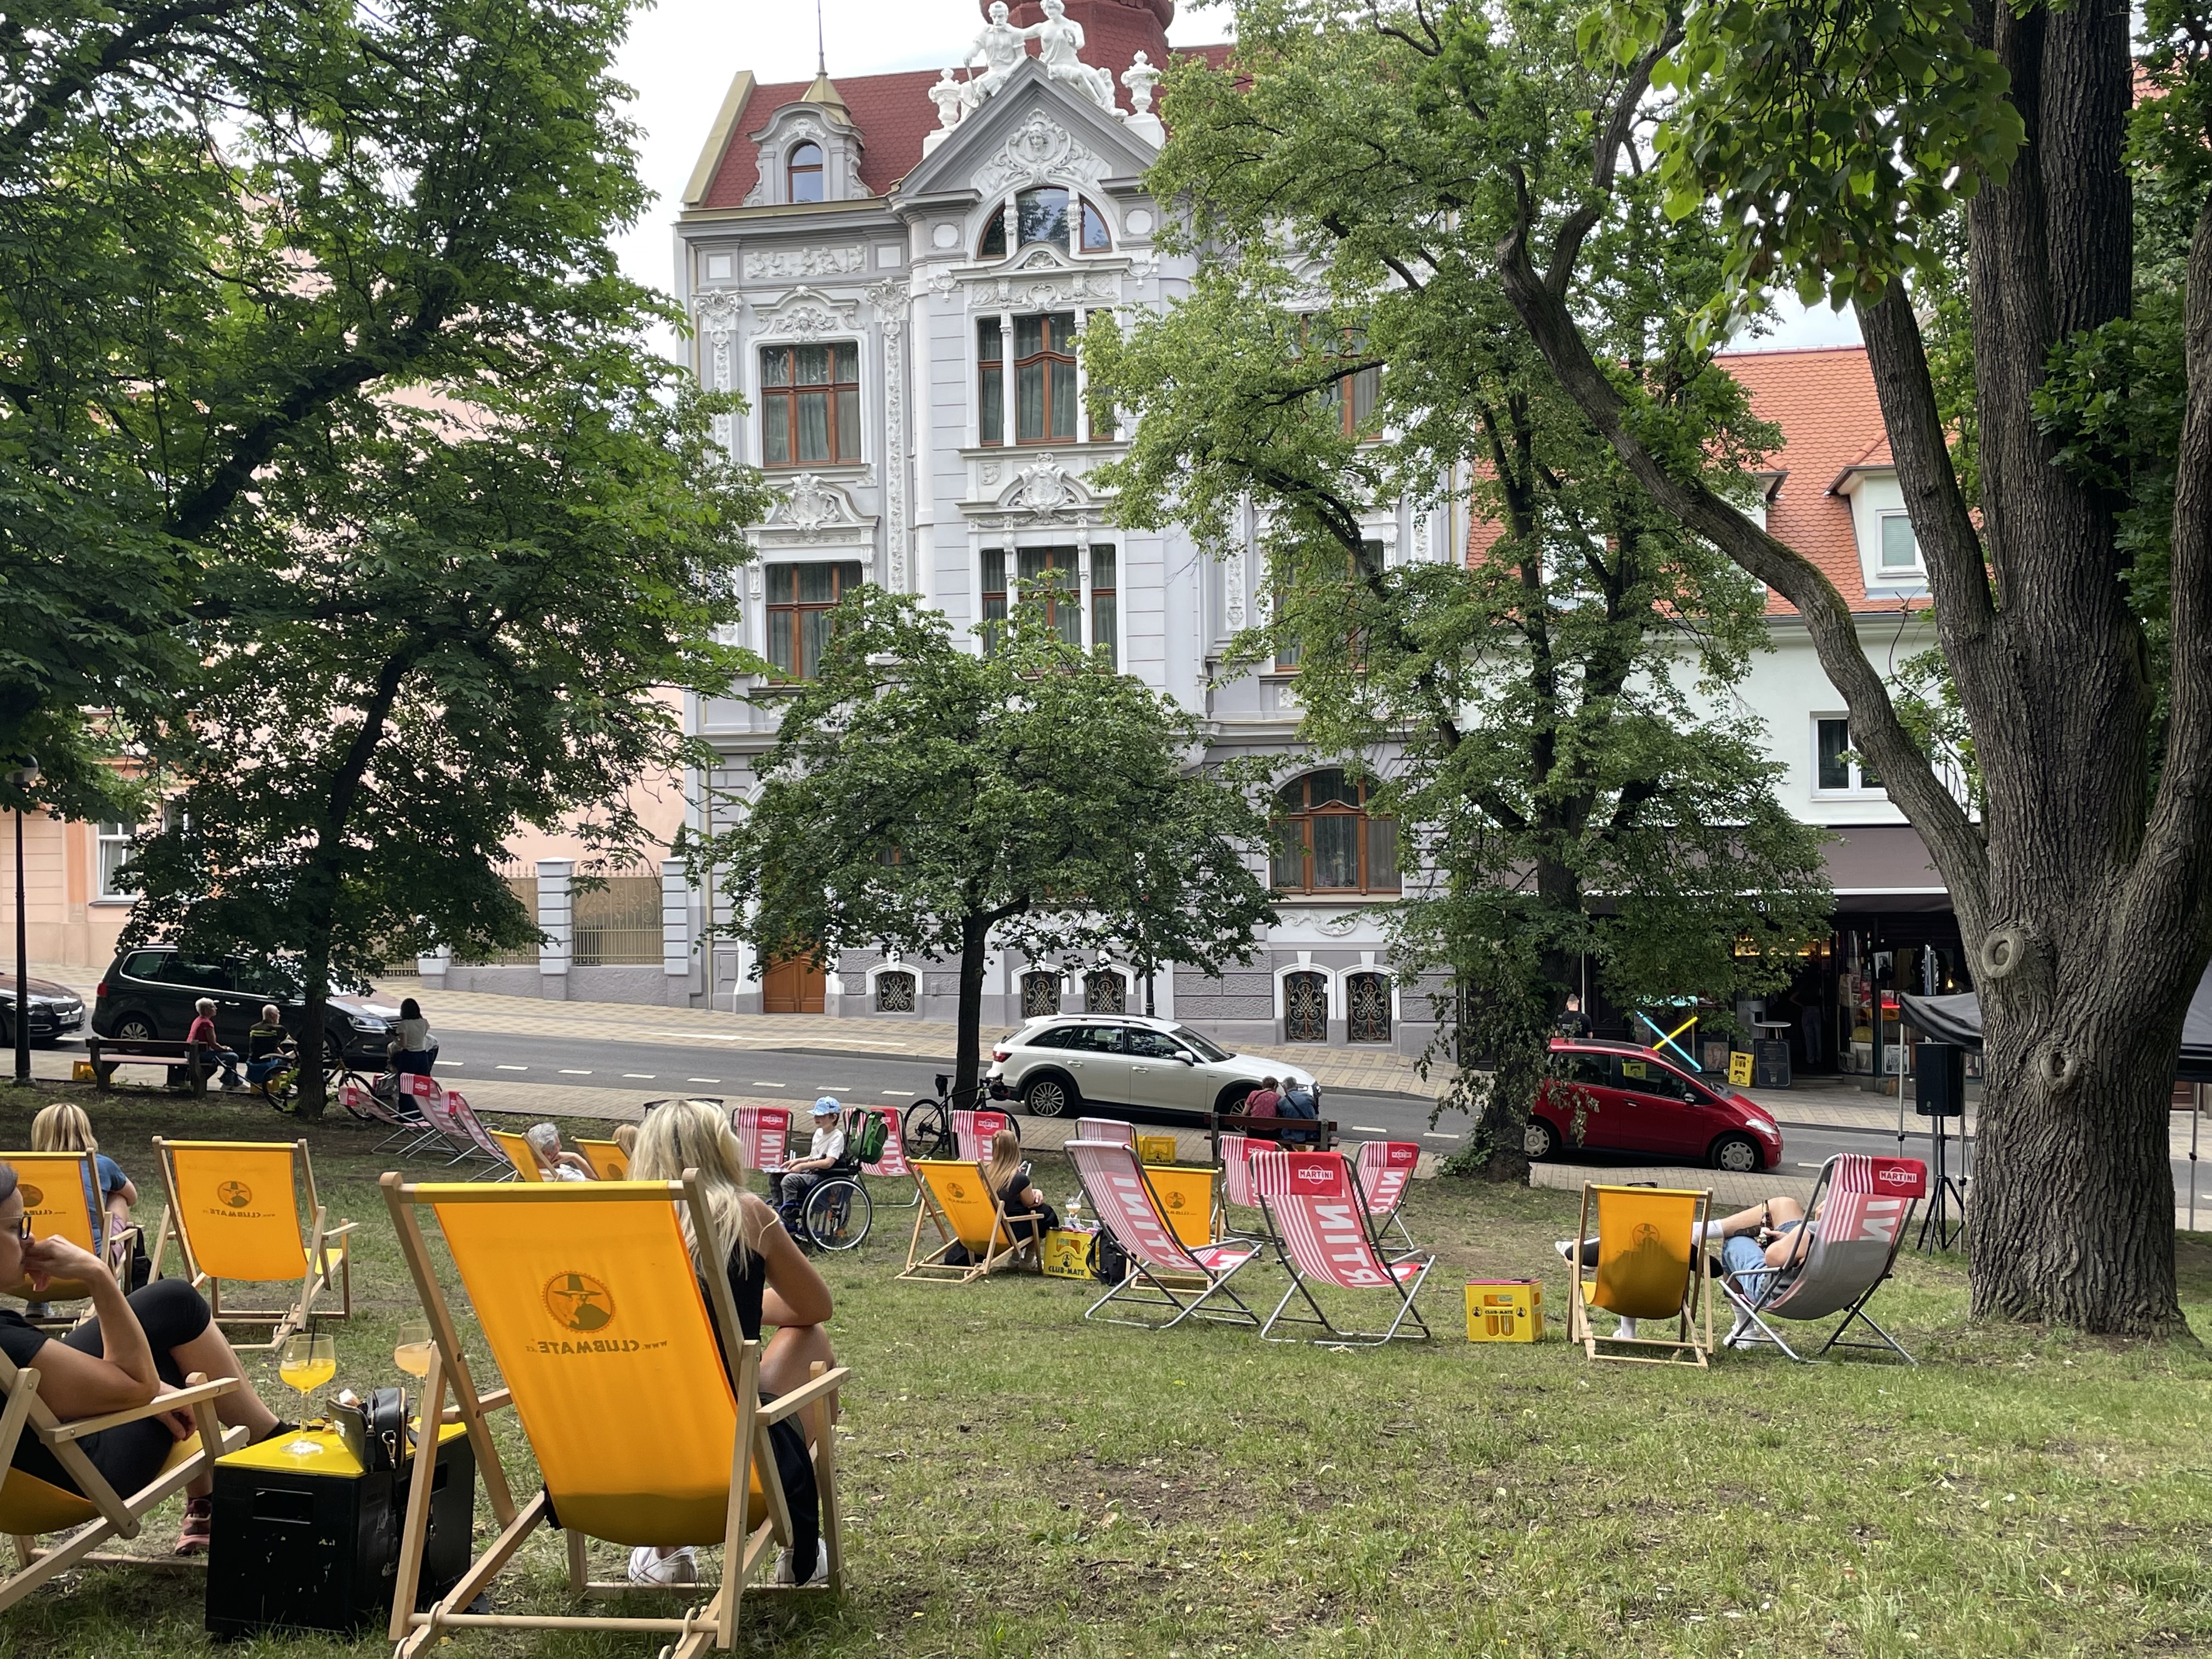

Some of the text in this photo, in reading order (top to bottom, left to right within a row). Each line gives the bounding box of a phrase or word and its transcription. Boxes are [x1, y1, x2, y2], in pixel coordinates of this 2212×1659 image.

[1300, 1171, 1332, 1179] MARTINI
[1881, 1171, 1916, 1181] MARTINI
[1048, 1266, 1085, 1276] CLUB-MATE
